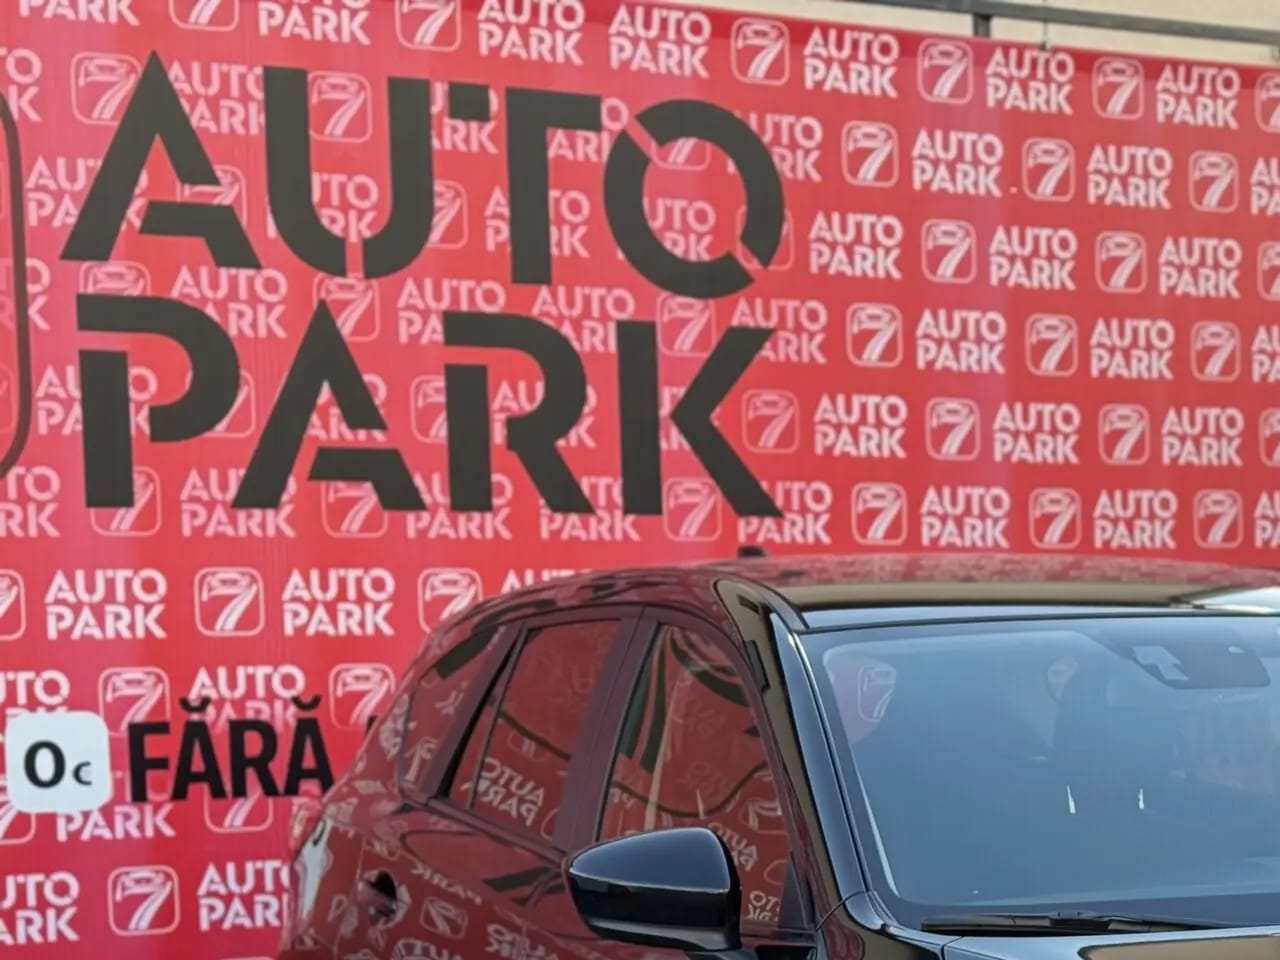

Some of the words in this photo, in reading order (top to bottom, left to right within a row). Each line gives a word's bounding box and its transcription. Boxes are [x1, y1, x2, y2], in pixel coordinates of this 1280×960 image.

[257, 1, 371, 46] PARK
[609, 5, 711, 44] AUTO
[479, 24, 582, 64] PARK
[609, 36, 710, 77] PARK
[804, 27, 899, 64] AUTO
[805, 60, 897, 97] PARK
[987, 47, 1074, 82] AUTO
[1156, 65, 1240, 97] AUTO
[987, 80, 1072, 114] PARK
[1157, 96, 1237, 129] PARK
[912, 128, 1003, 165] AUTO
[1087, 145, 1172, 178] AUTO
[61, 50, 785, 299] AUTO
[913, 162, 1001, 197] PARK
[1088, 177, 1170, 209] PARK
[809, 212, 903, 247] AUTO
[989, 226, 1077, 260] AUTO
[810, 246, 901, 279] PARK
[1159, 237, 1242, 269] AUTO
[171, 265, 288, 301] AUTO
[990, 259, 1076, 290] PARK
[1160, 269, 1240, 298] PARK
[397, 276, 506, 312] AUTO
[533, 287, 635, 318] AUTO
[732, 298, 827, 331] AUTO
[916, 309, 1006, 343] AUTO
[1090, 318, 1174, 350] AUTO
[917, 340, 1004, 374] PARK
[1091, 350, 1173, 379] PARK
[77, 294, 784, 518] PARK
[815, 394, 907, 428] AUTO
[993, 402, 1080, 433] AUTO
[1162, 407, 1244, 437] AUTO
[815, 427, 906, 458] PARK
[994, 433, 1078, 464] PARK
[1162, 437, 1242, 466] PARK
[920, 486, 1010, 519] AUTO
[1093, 490, 1177, 519] AUTO
[181, 503, 296, 538] PARK
[922, 516, 1008, 548] PARK
[1094, 519, 1175, 548] PARK
[45, 568, 167, 603] AUTO
[282, 568, 395, 603] AUTO
[47, 604, 166, 640] PARK
[284, 601, 394, 636] PARK
[189, 665, 305, 699] AUTO
[128, 695, 334, 803] FĂRĂ
[57, 803, 175, 842] PARK
[197, 860, 289, 895] AUT
[199, 894, 287, 931] PAR
